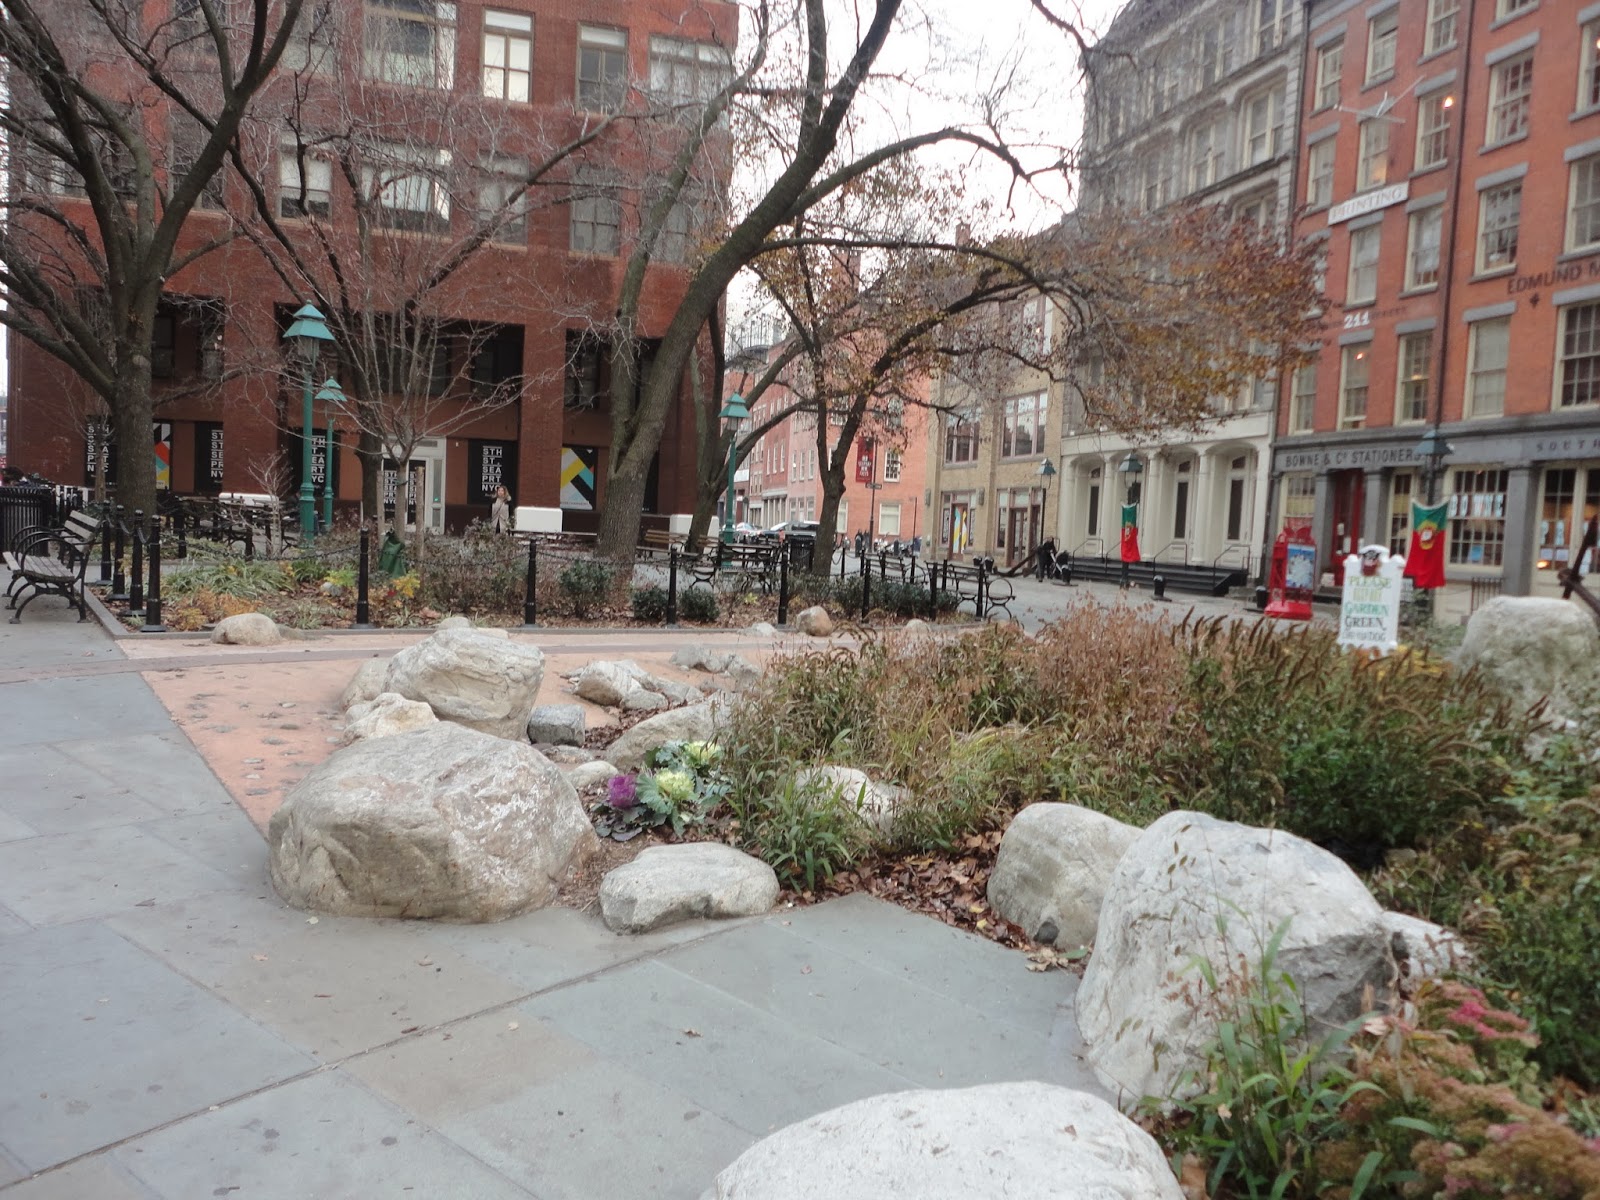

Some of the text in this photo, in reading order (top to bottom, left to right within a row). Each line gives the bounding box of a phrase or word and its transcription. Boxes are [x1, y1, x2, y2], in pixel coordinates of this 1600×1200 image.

[1507, 266, 1582, 294] EDMUND
[211, 432, 223, 440] ST
[312, 438, 325, 446] TH
[211, 451, 223, 459] SE
[483, 448, 502, 456] STH
[311, 456, 325, 464] EA
[1286, 455, 1319, 467] BOWNE
[211, 470, 223, 478] NY
[483, 466, 501, 474] SEA
[311, 475, 325, 483] YC
[482, 475, 501, 483] PRT
[1344, 615, 1387, 631] GREEN
